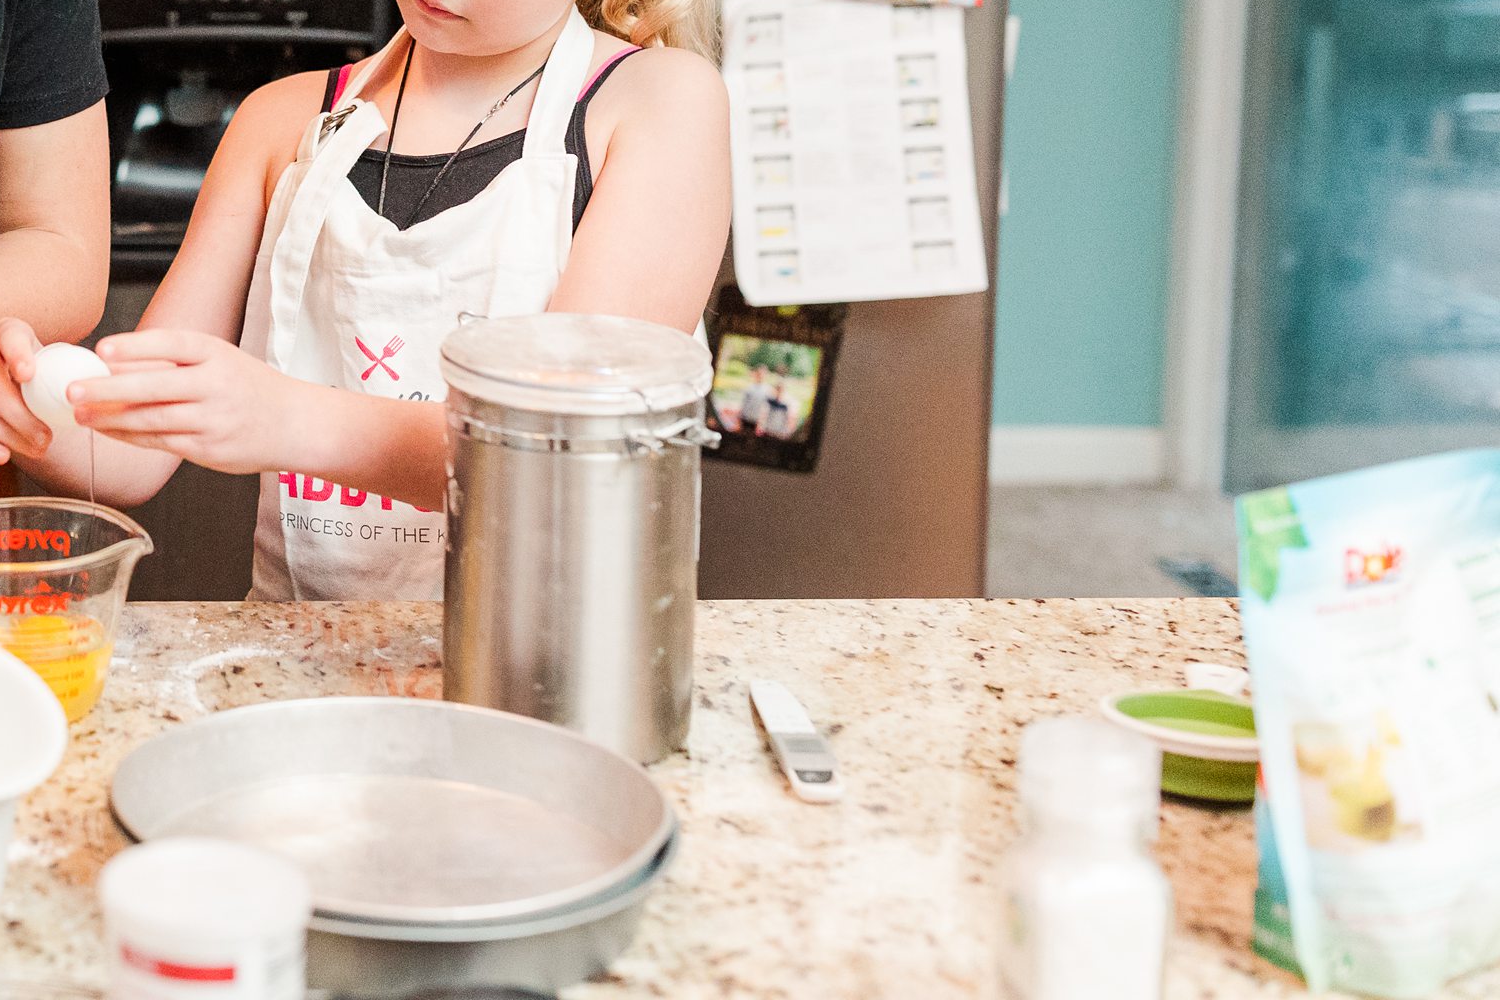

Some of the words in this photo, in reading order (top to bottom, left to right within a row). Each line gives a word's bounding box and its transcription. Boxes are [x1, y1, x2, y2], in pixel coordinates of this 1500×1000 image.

[279, 511, 353, 538] PRINCESS
[360, 524, 384, 540] OF
[391, 527, 430, 543] THE
